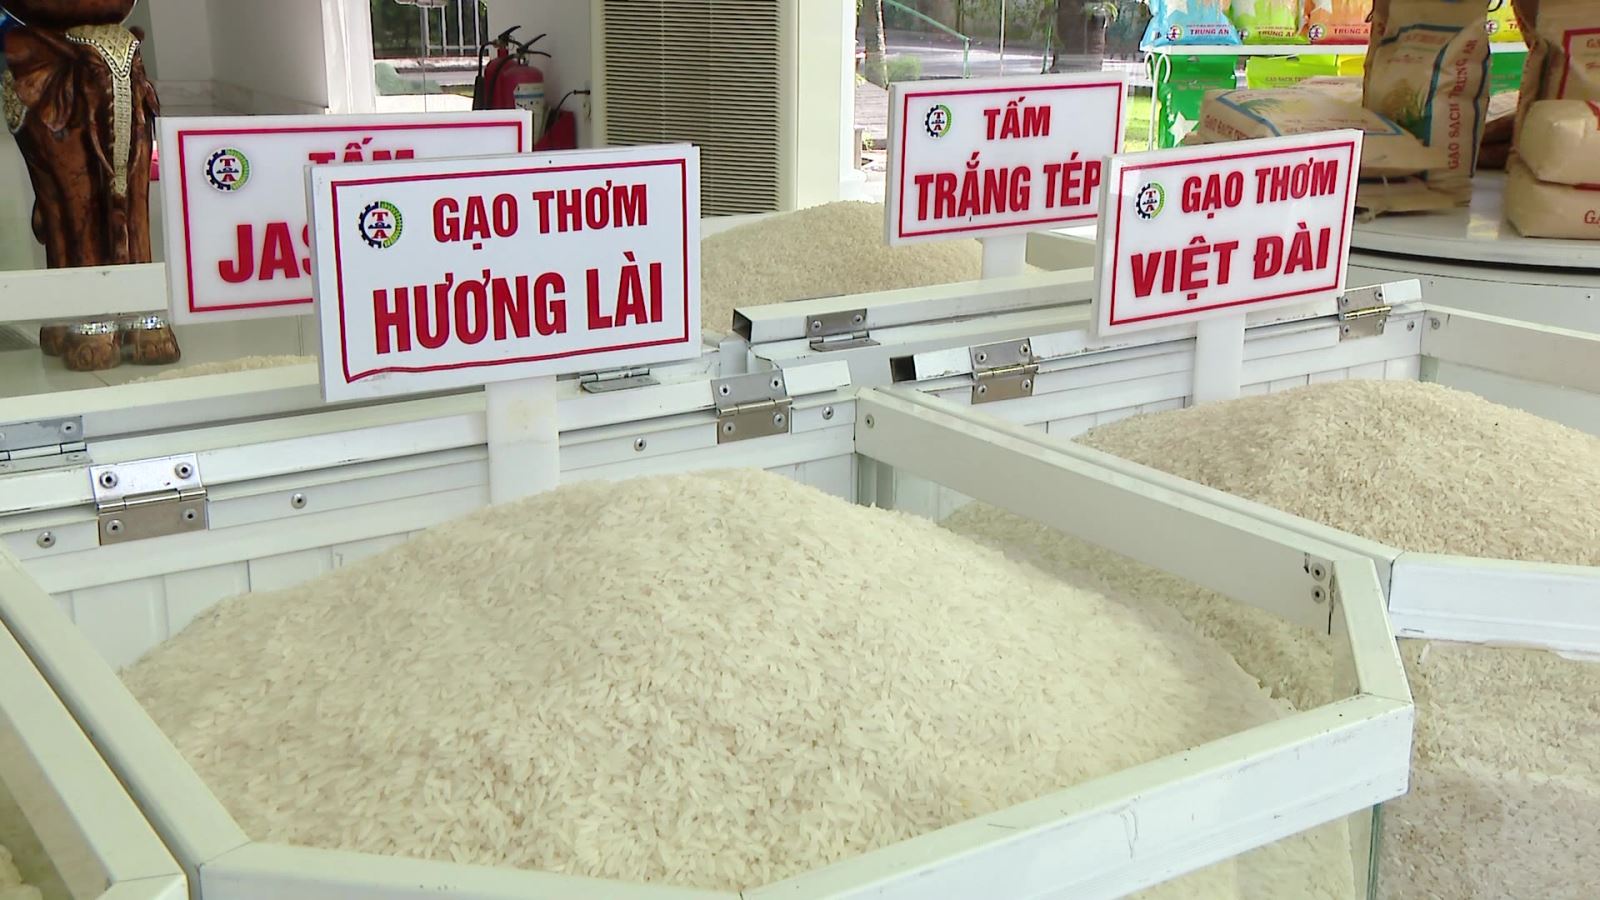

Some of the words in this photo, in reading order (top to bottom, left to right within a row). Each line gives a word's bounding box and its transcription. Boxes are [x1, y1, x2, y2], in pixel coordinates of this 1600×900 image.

[984, 96, 1052, 141] TẤM
[432, 193, 519, 251] GẠO
[532, 179, 648, 234] THƠM
[914, 151, 1031, 221] TRẮNG
[1042, 151, 1102, 209] TÉP
[1181, 172, 1244, 220] GẠO
[1255, 156, 1339, 204] THƠM
[1130, 235, 1239, 301] VIỆT
[1252, 222, 1332, 281] ĐÀI
[373, 269, 568, 355] HƯƠNG
[586, 250, 663, 331] LÀI
